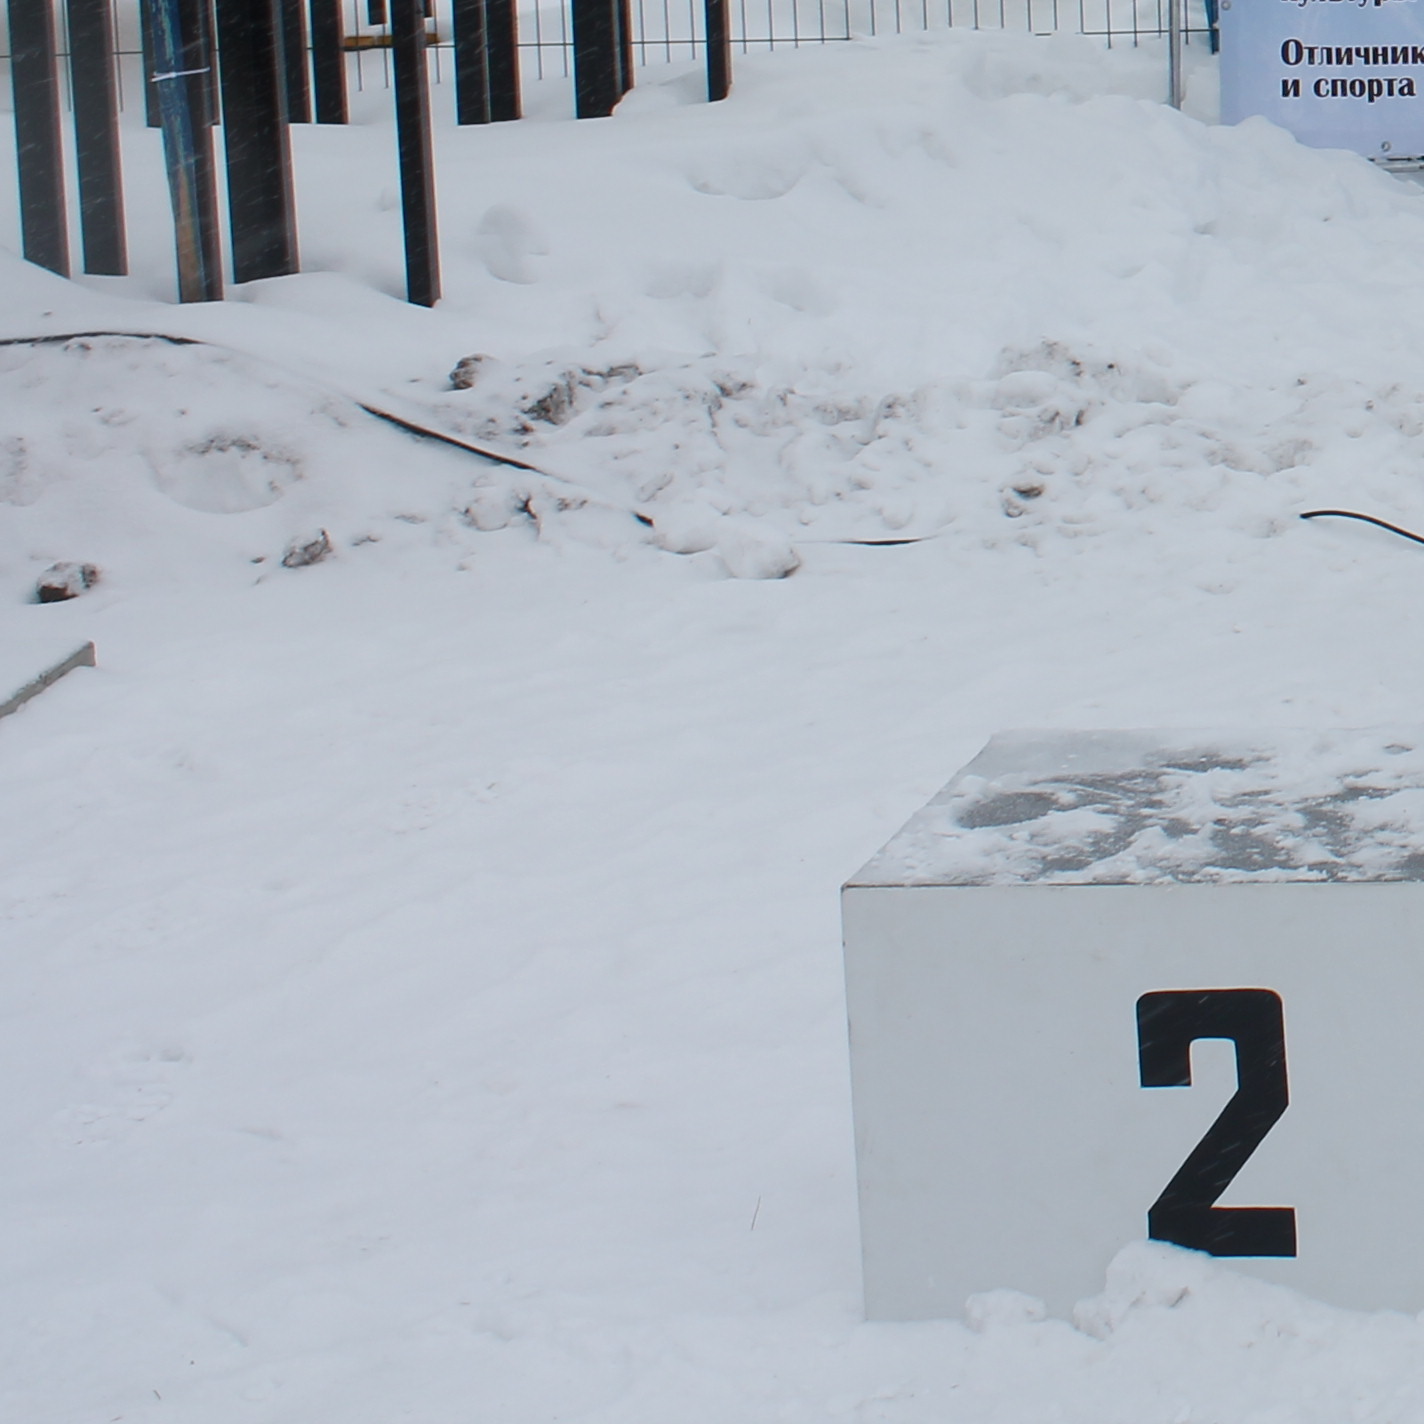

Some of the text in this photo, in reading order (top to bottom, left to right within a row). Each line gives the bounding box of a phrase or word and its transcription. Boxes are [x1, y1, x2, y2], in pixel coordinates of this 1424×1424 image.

[1282, 79, 1300, 97] и
[1313, 77, 1416, 102] спорта
[1135, 988, 1297, 1259] 2
